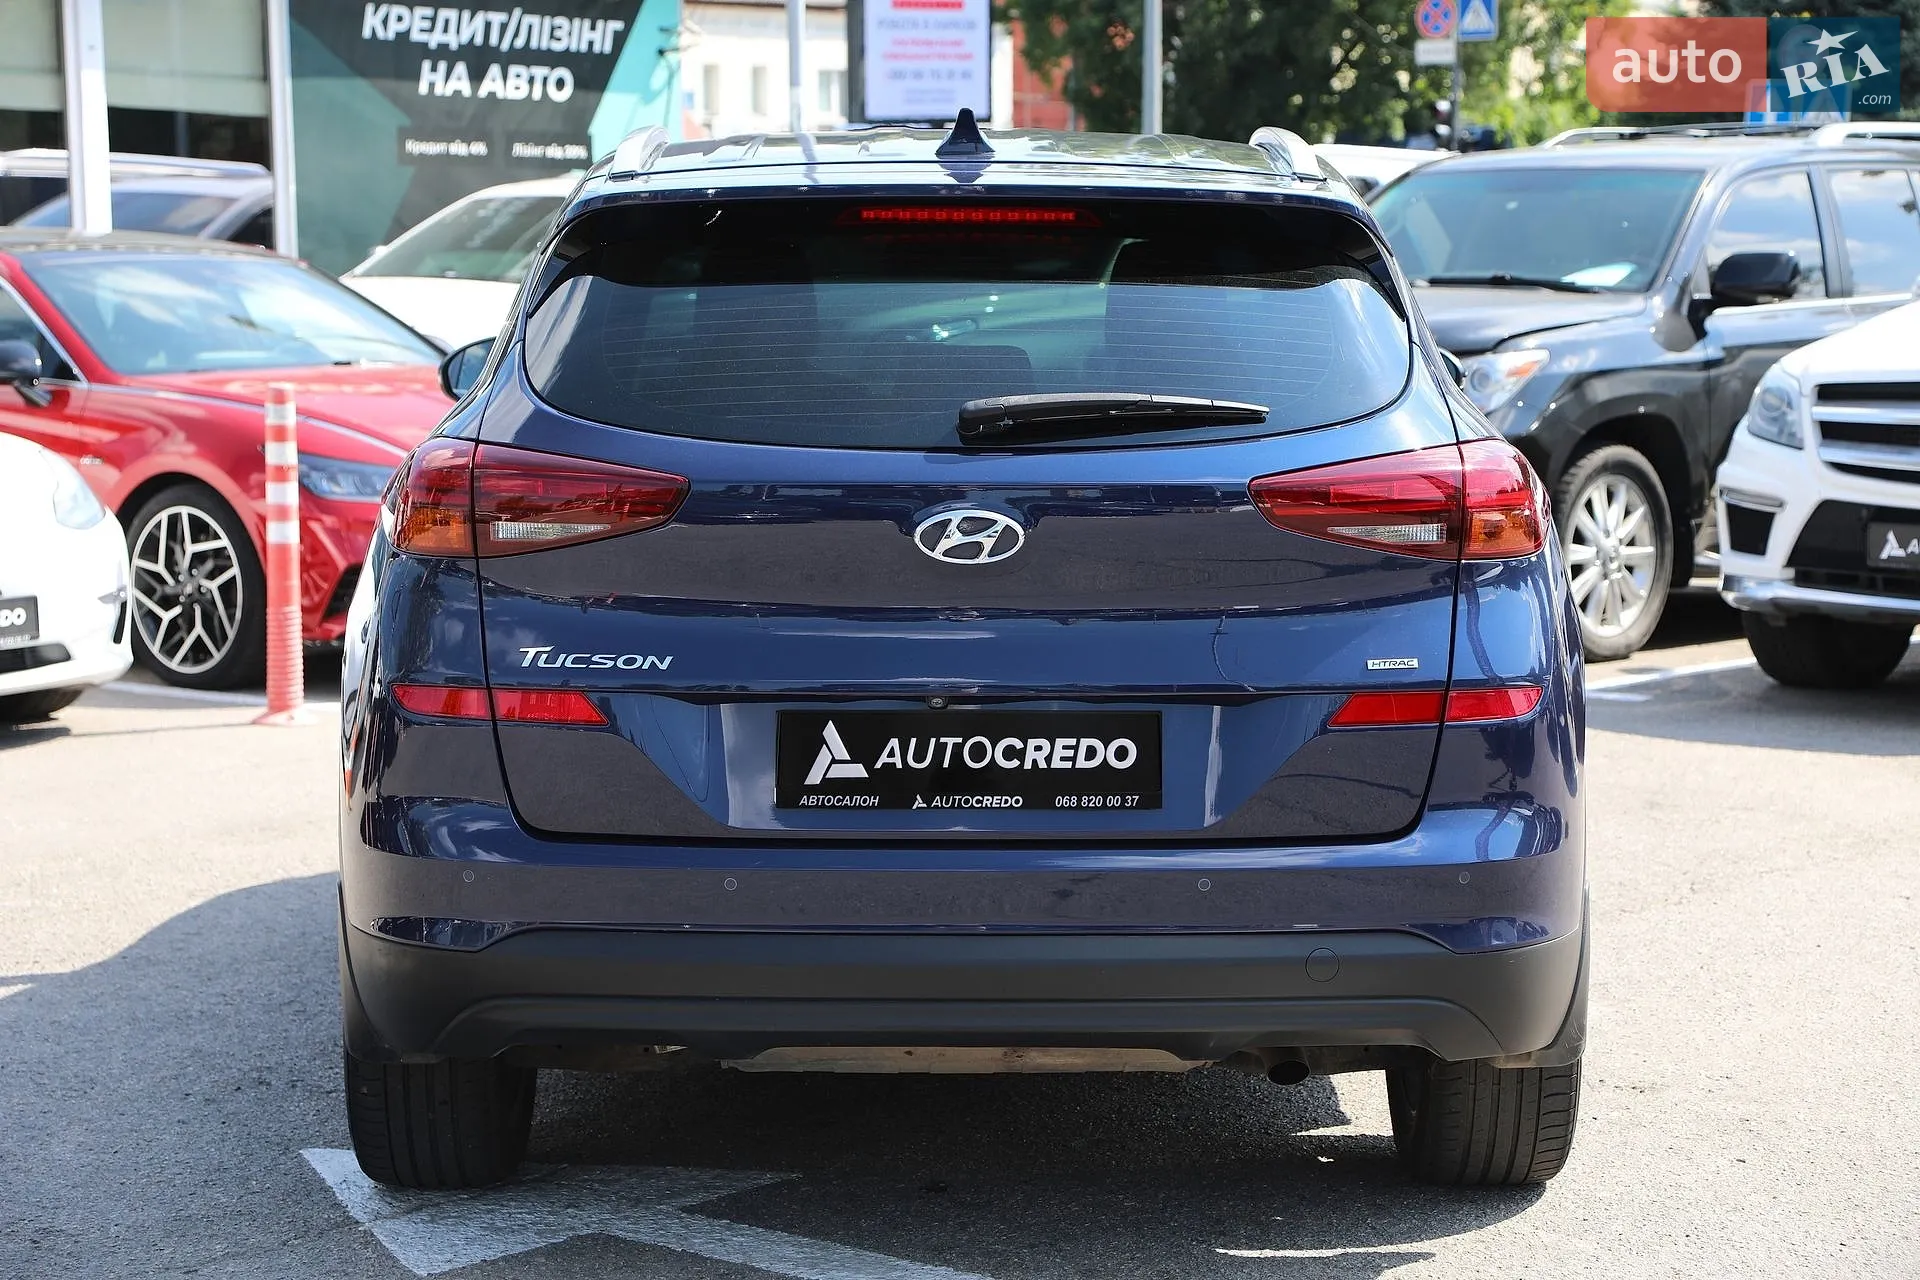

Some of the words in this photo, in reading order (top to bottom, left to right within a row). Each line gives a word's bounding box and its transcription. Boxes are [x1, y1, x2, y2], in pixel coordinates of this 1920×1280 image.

[361, 2, 626, 54] КРЕДИТ/ЛІЗІНГ
[418, 59, 473, 97] НА
[477, 62, 575, 103] АВТО
[1369, 658, 1416, 669] HTRAC
[873, 735, 1137, 770] AUTOCREDO
[799, 795, 880, 807] АВТОСАЛОН
[931, 795, 1023, 808] AUTOCREDO
[1055, 795, 1078, 808] 068
[1081, 795, 1103, 808] 820
[1106, 795, 1122, 808] 00
[1125, 795, 1140, 808] 37
